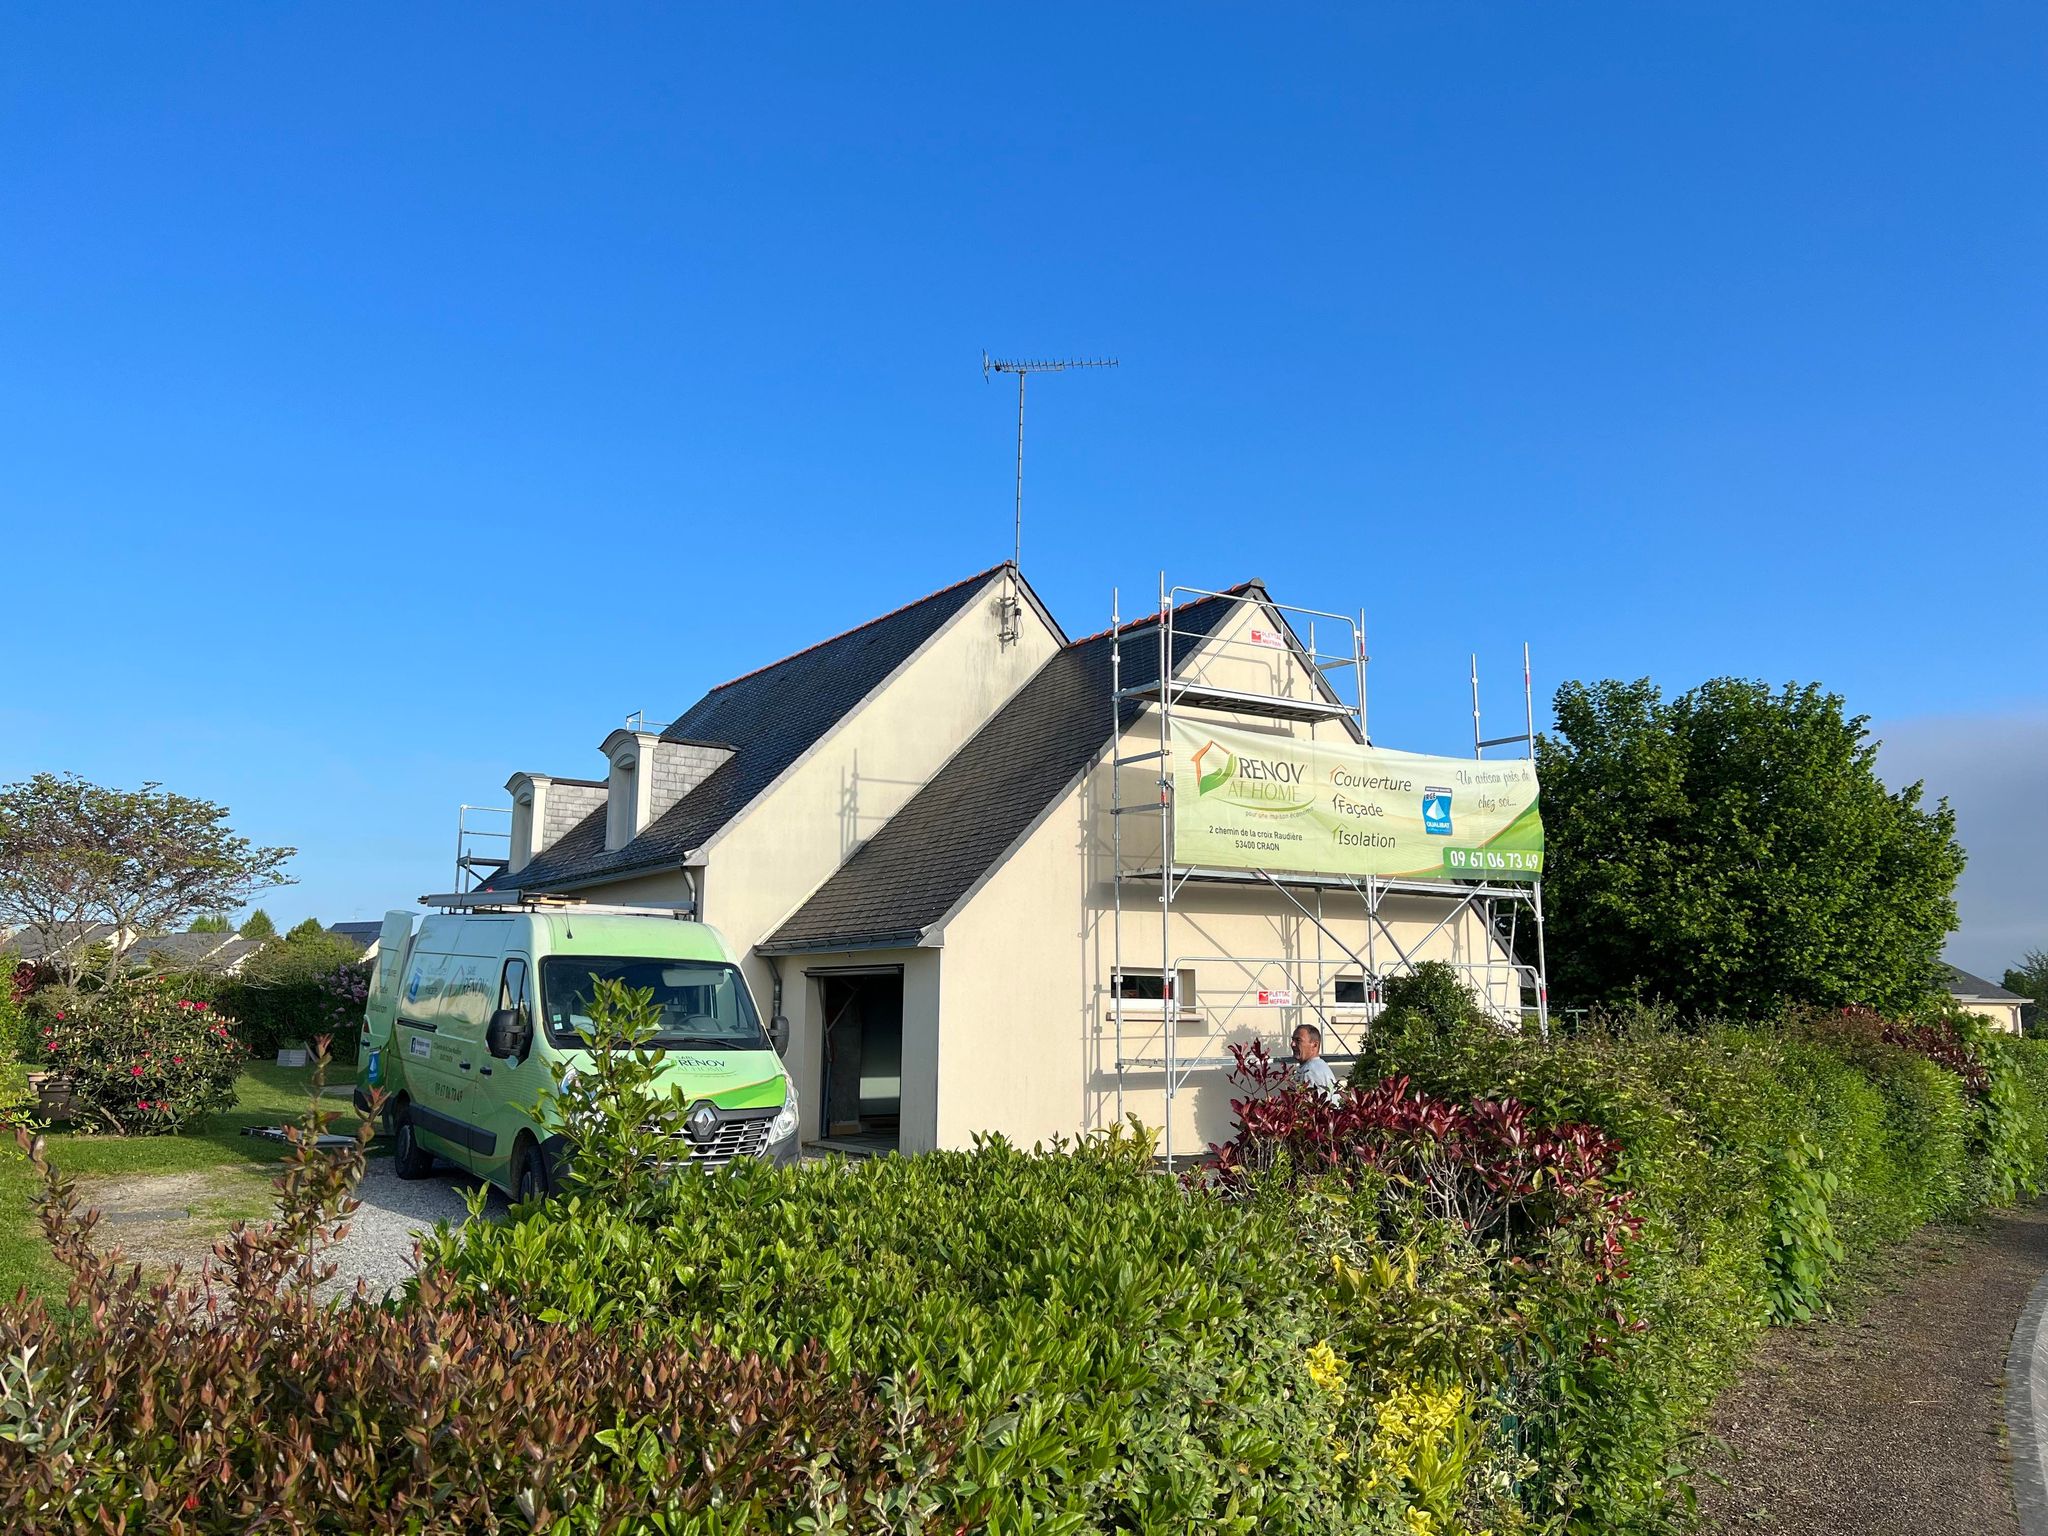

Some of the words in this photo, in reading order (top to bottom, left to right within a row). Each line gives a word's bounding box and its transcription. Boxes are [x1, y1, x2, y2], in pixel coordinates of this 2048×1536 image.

[1334, 771, 1412, 792] Couverture
[1456, 770, 1473, 785] Un
[1475, 772, 1502, 785] artisan
[1228, 780, 1245, 798] AT
[1251, 782, 1299, 803] HOME
[1338, 800, 1384, 818] Façade
[1478, 794, 1495, 812] chez
[1209, 825, 1214, 834] 2
[1215, 827, 1240, 836] chemin
[1240, 829, 1249, 837] de
[1249, 830, 1256, 838] la
[1274, 831, 1303, 841] Raudière
[1338, 830, 1396, 848] Isolation
[1235, 840, 1256, 850] 53400
[1256, 841, 1280, 851] CRAON
[1450, 850, 1466, 867] 09
[1470, 851, 1484, 867] 67
[1487, 852, 1505, 868] 06
[1507, 853, 1523, 869] 73
[1526, 854, 1538, 869] 49
